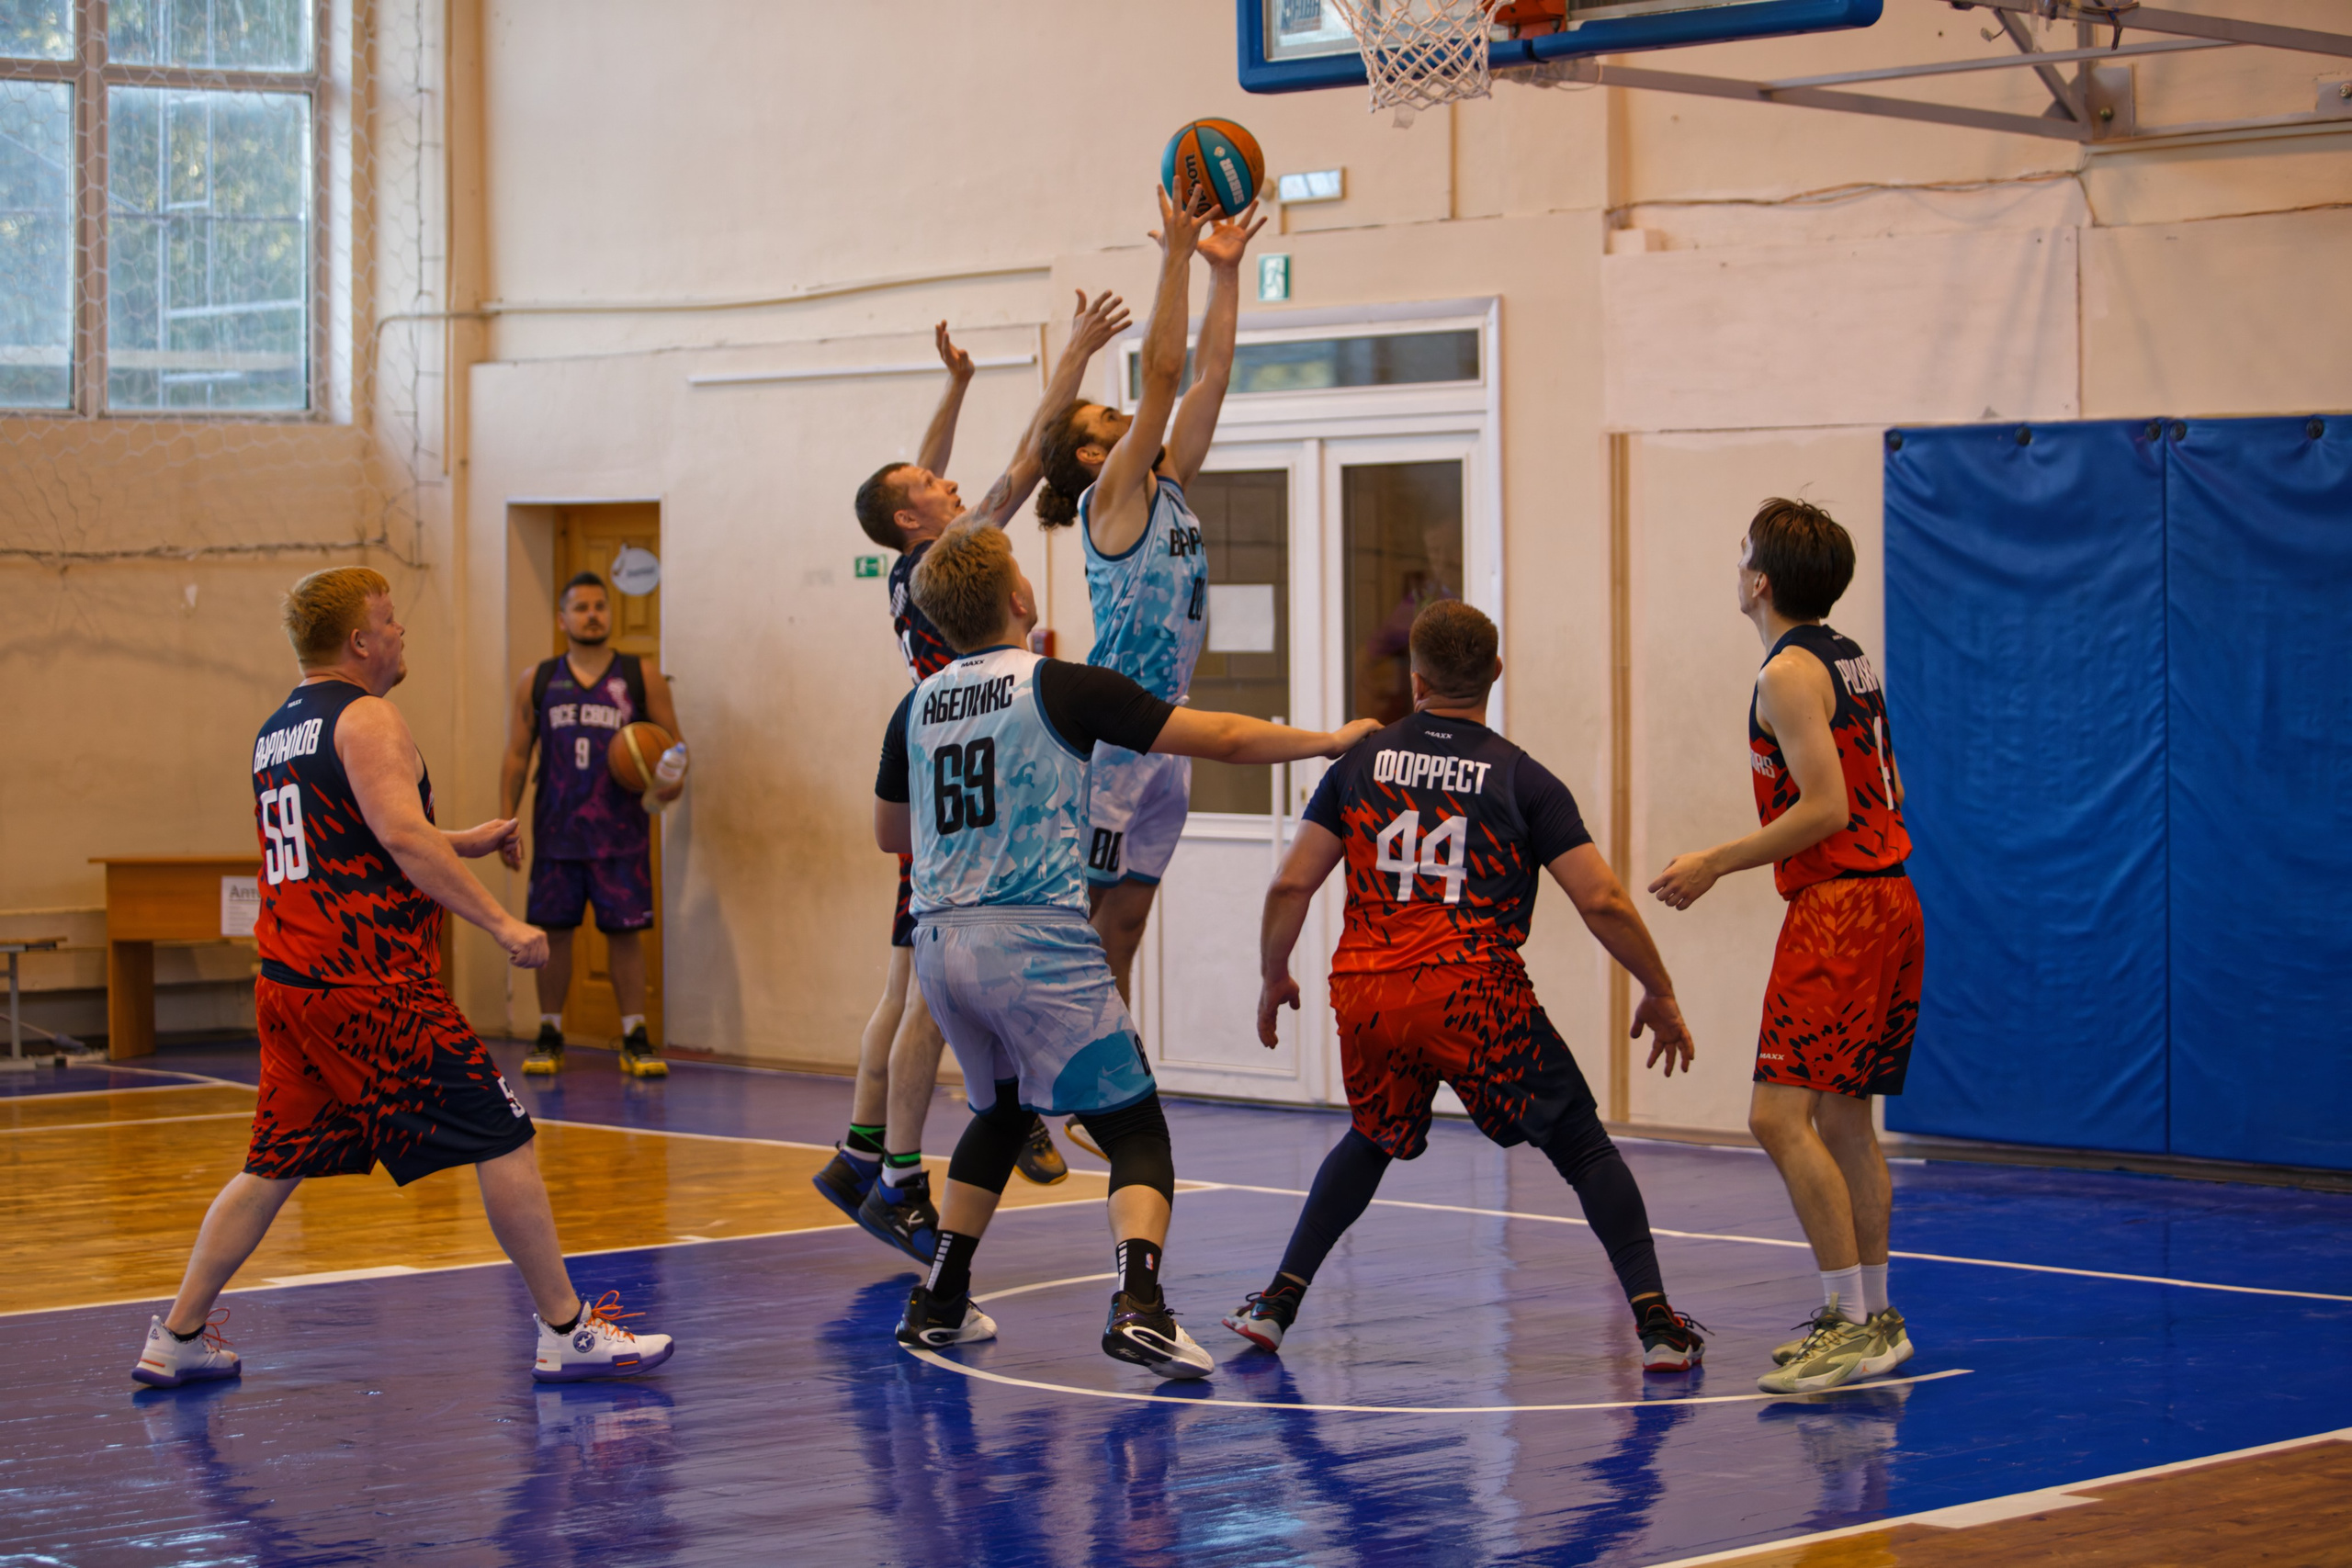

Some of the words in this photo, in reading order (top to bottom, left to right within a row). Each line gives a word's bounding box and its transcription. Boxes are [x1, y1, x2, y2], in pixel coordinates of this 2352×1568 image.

[1219, 158, 1245, 205] SIBUR
[1170, 526, 1204, 557] ВАР
[961, 659, 985, 669] MAXX
[922, 674, 1014, 726] АБЕЛИКС
[254, 718, 323, 774] ВАРЛАМОВ
[575, 737, 590, 770] 9
[1424, 730, 1453, 739] MAXX
[934, 737, 996, 835] 69
[1374, 749, 1491, 795] ФОРРЕСТ
[260, 784, 309, 886] 59
[1375, 809, 1467, 904] 44
[1759, 1053, 1785, 1061] MAXX
